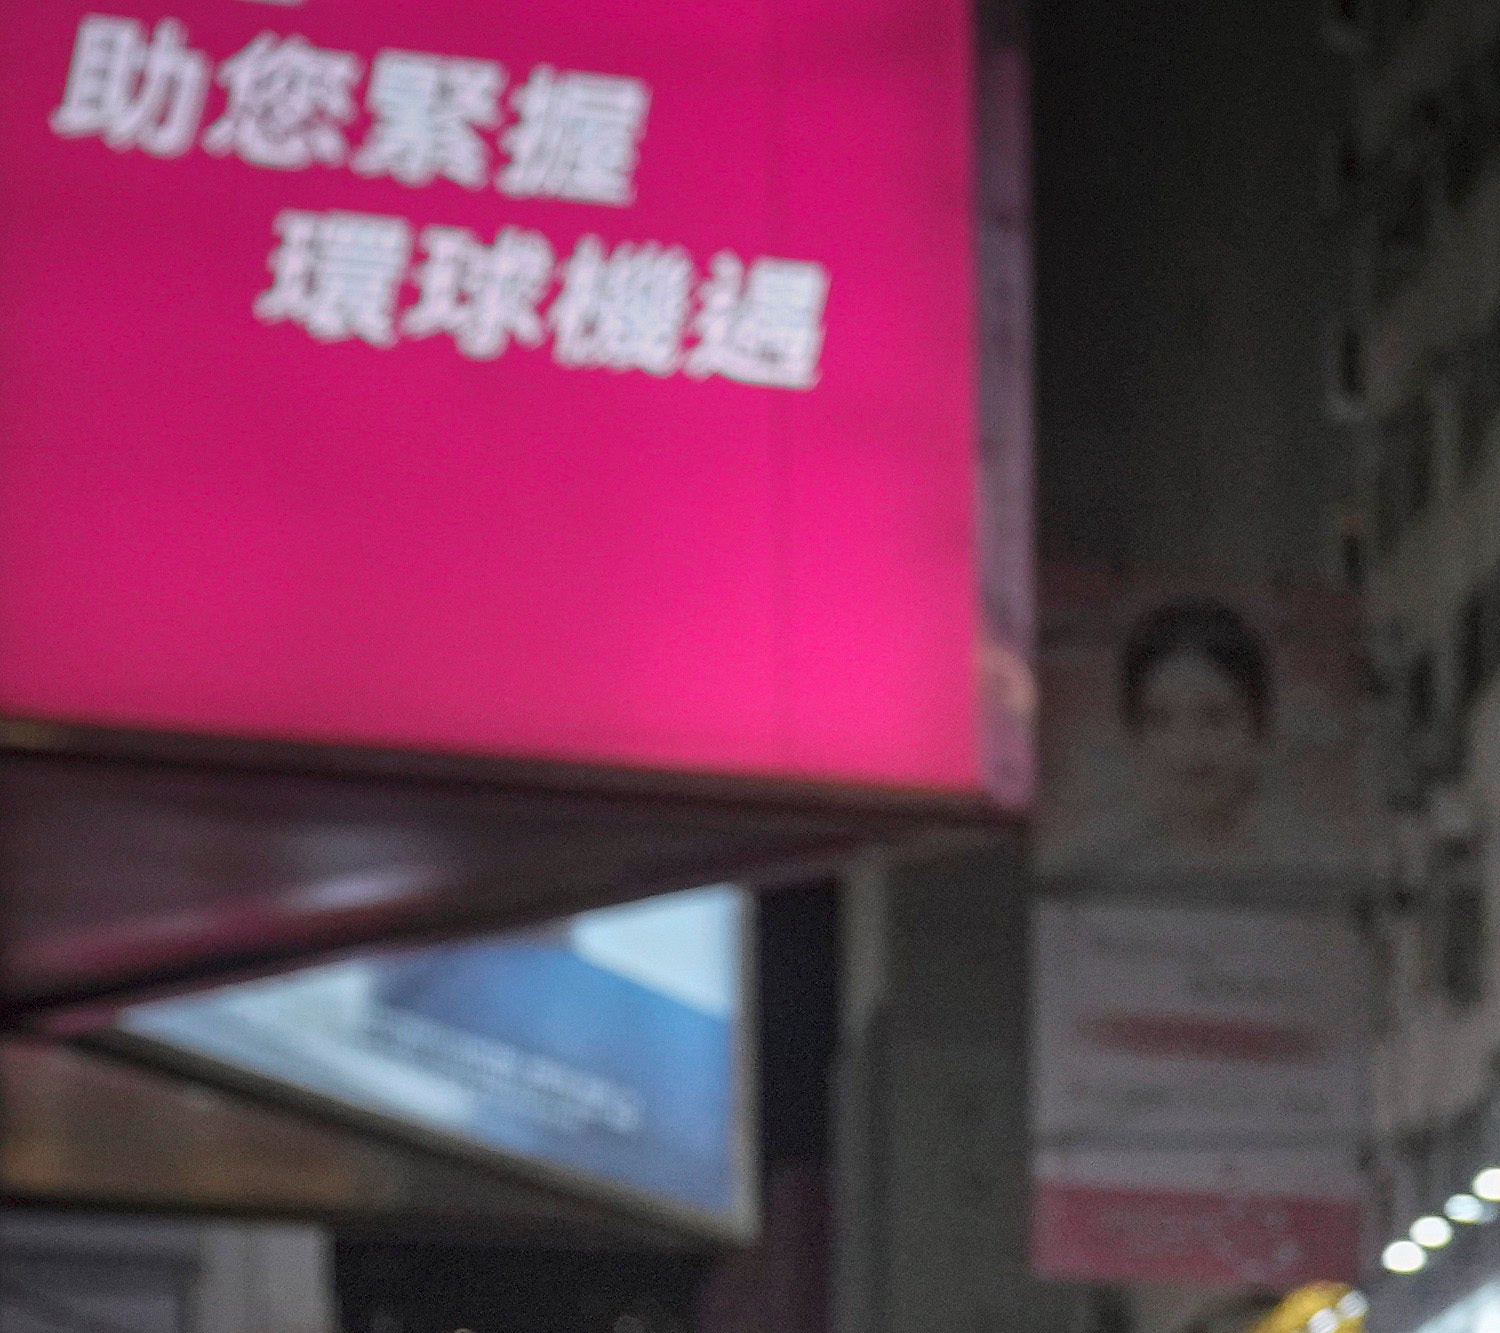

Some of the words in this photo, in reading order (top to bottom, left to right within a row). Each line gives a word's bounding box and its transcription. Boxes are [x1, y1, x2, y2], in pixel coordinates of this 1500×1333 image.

[53, 12, 650, 206] 助您緊握
[254, 209, 830, 391] 環球機遇
